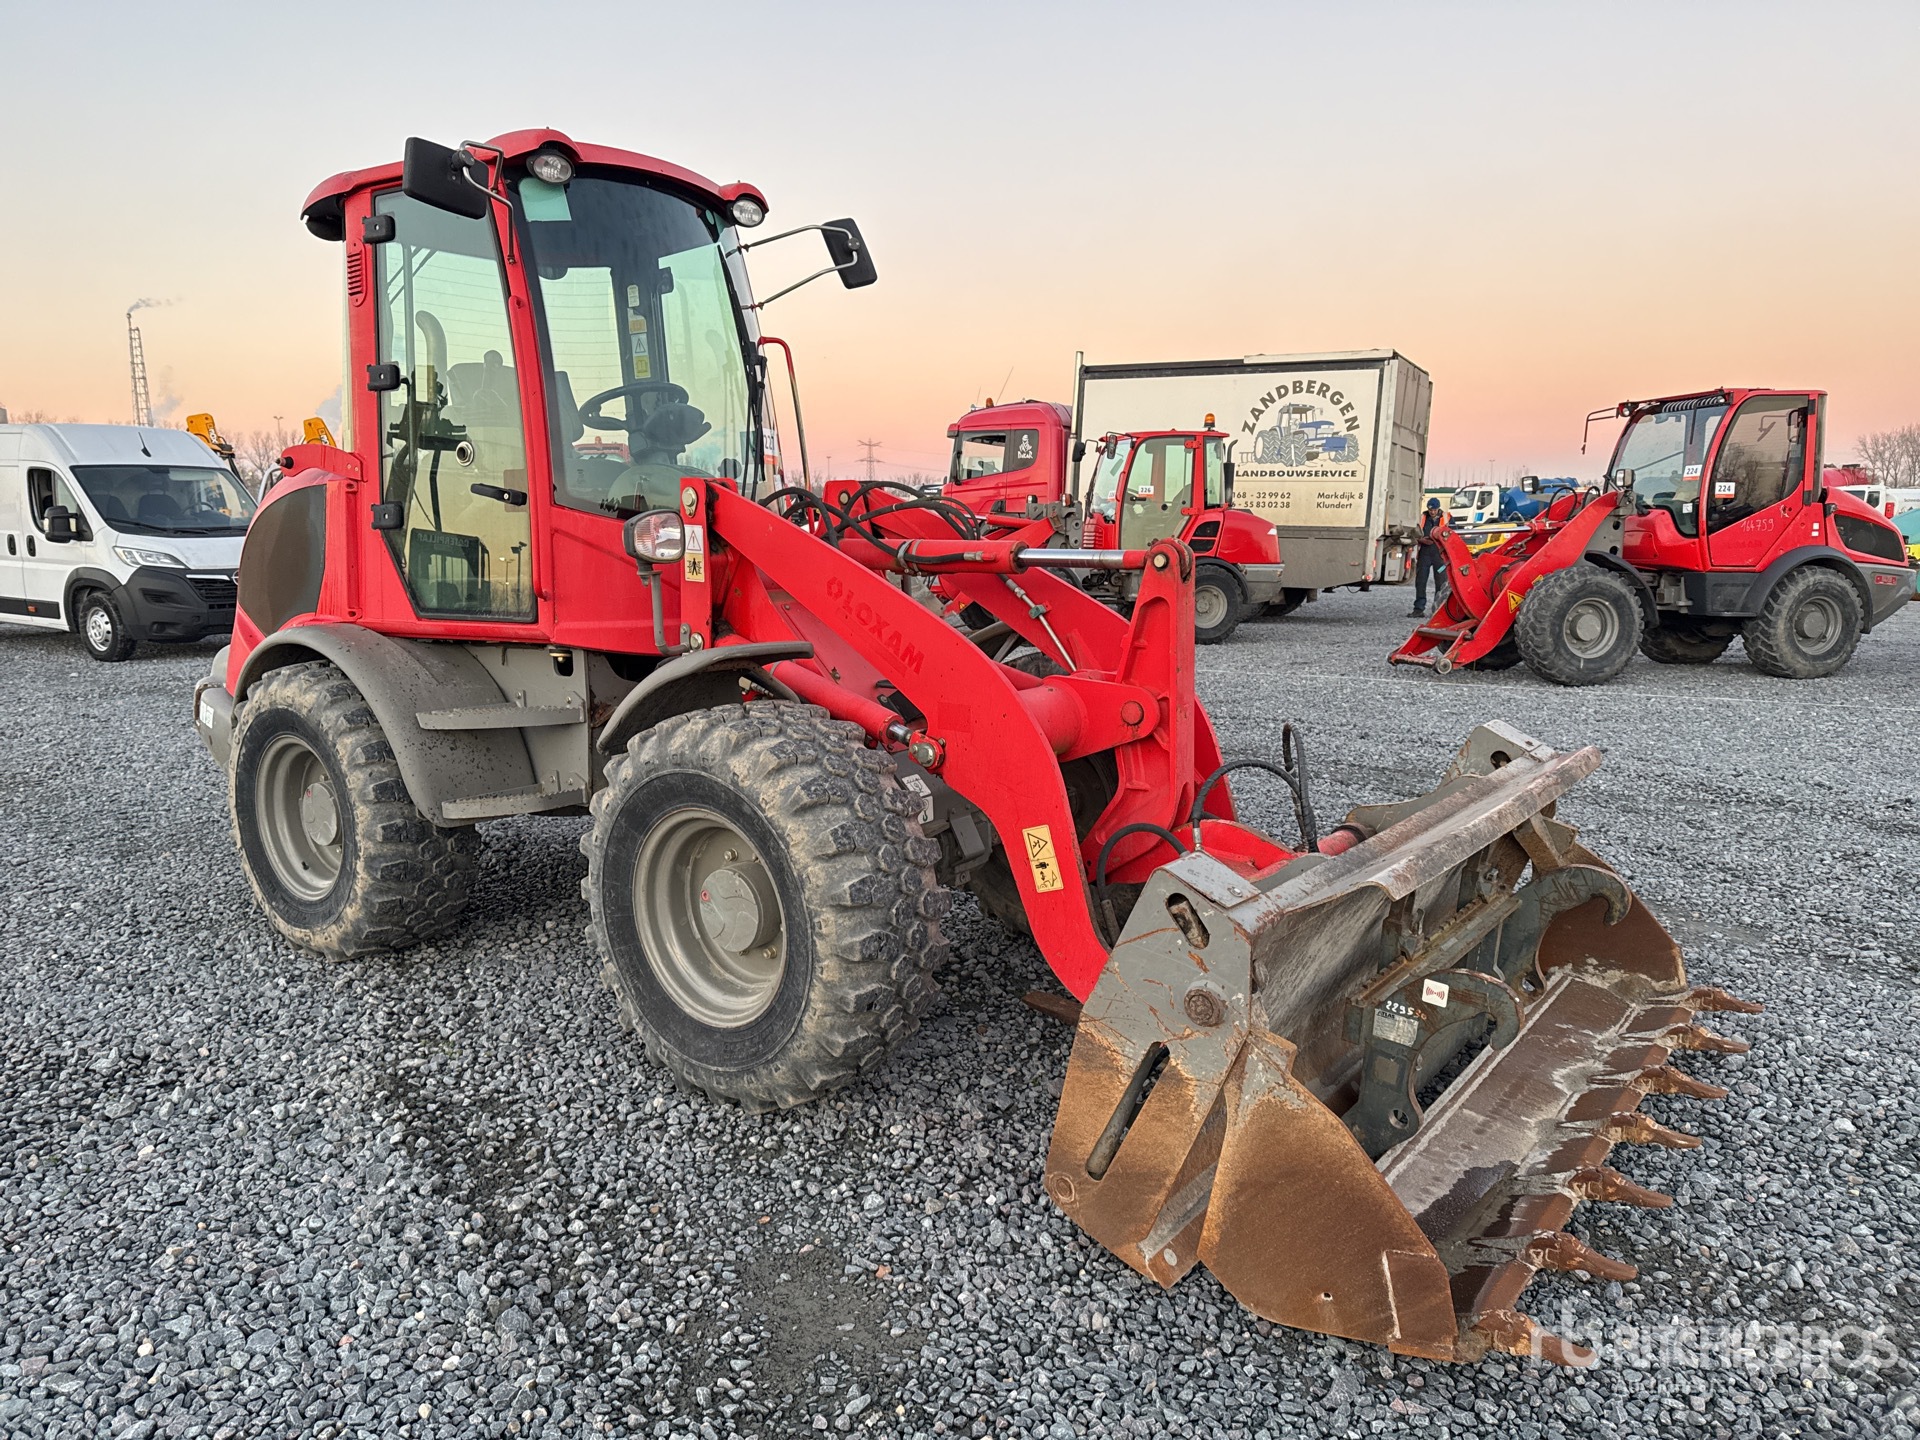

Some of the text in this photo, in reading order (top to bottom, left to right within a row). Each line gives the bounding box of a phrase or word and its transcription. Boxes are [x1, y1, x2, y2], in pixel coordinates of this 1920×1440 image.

[1241, 380, 1360, 435] ZANDBERGEN
[1686, 467, 1698, 475] 224
[1317, 491, 1355, 501] Markdijk
[1316, 501, 1353, 509] Klundert
[842, 590, 925, 675] LOXAM
